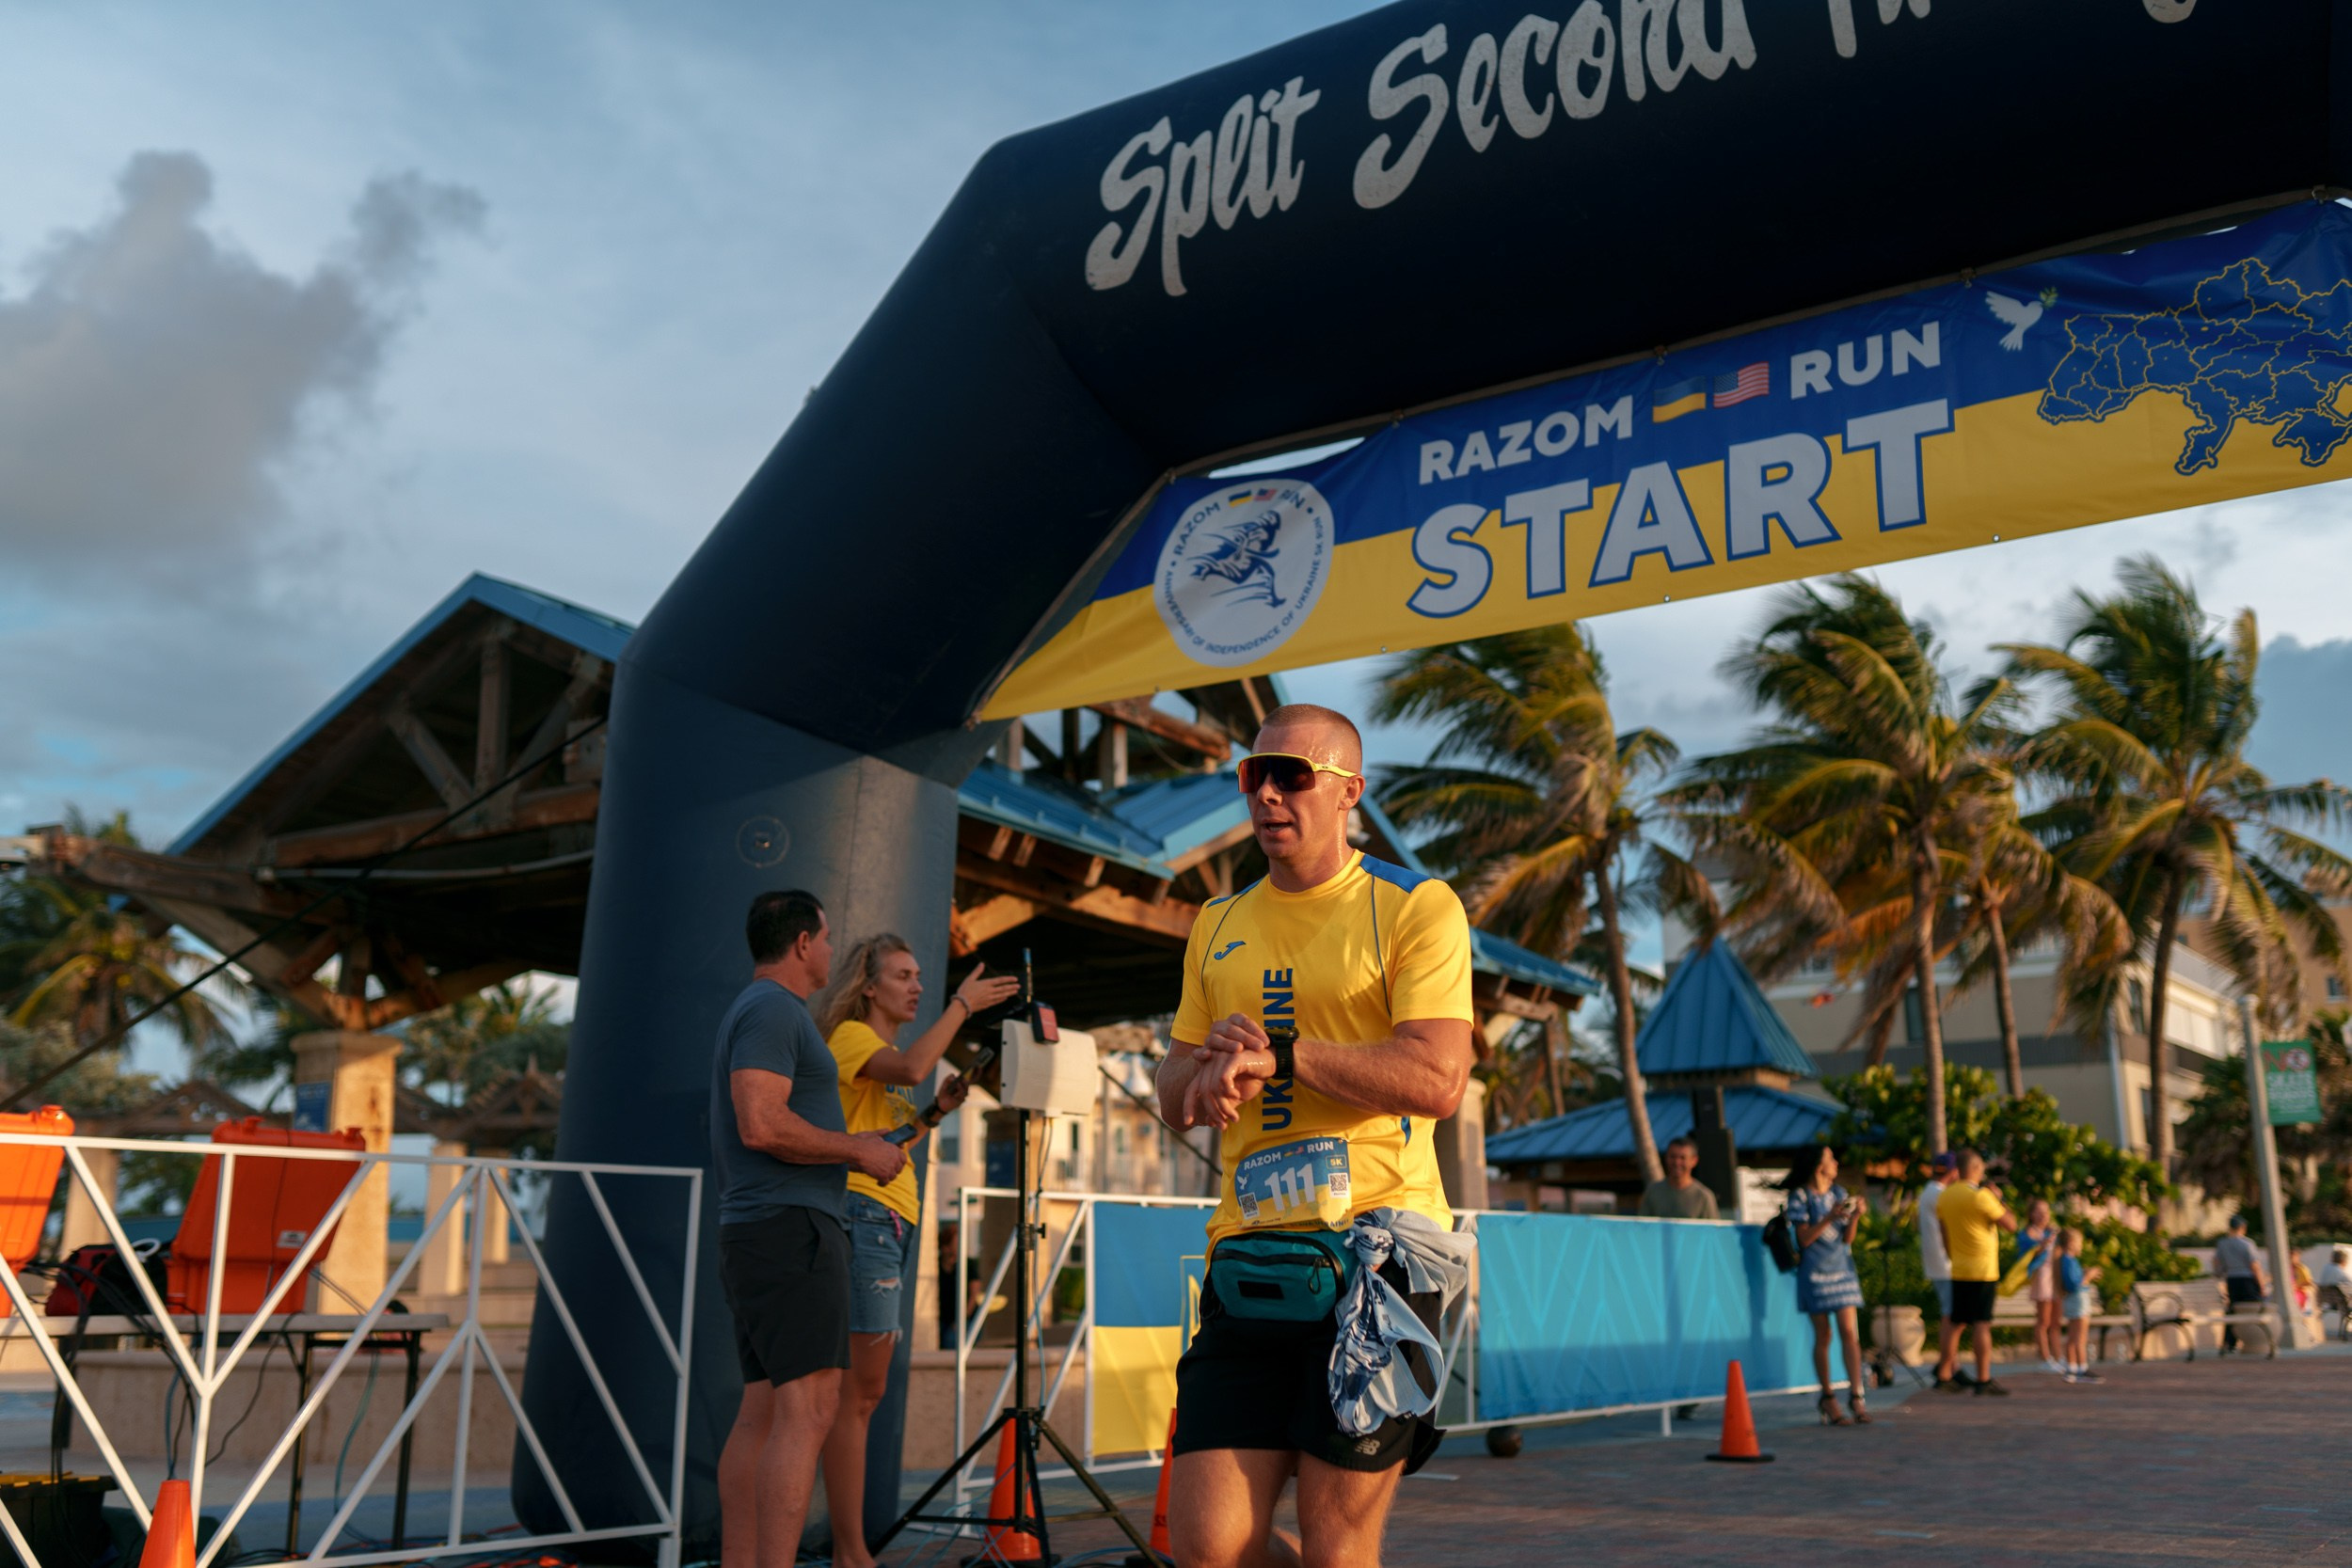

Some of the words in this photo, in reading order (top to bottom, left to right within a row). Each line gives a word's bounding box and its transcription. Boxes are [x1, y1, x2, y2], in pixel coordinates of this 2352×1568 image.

[1084, 75, 1321, 296] Split
[1419, 395, 1633, 485] RAZOM
[1789, 320, 1942, 401] RUN
[1173, 501, 1221, 556] RAZOM
[1405, 397, 1956, 620] START
[1280, 610, 1295, 627] OF
[1295, 559, 1322, 610] UKRAINE
[1262, 968, 1295, 1131] UKINE
[1244, 1151, 1282, 1170] RAZOM
[1307, 1141, 1334, 1153] RUN
[1264, 1163, 1316, 1212] 111
